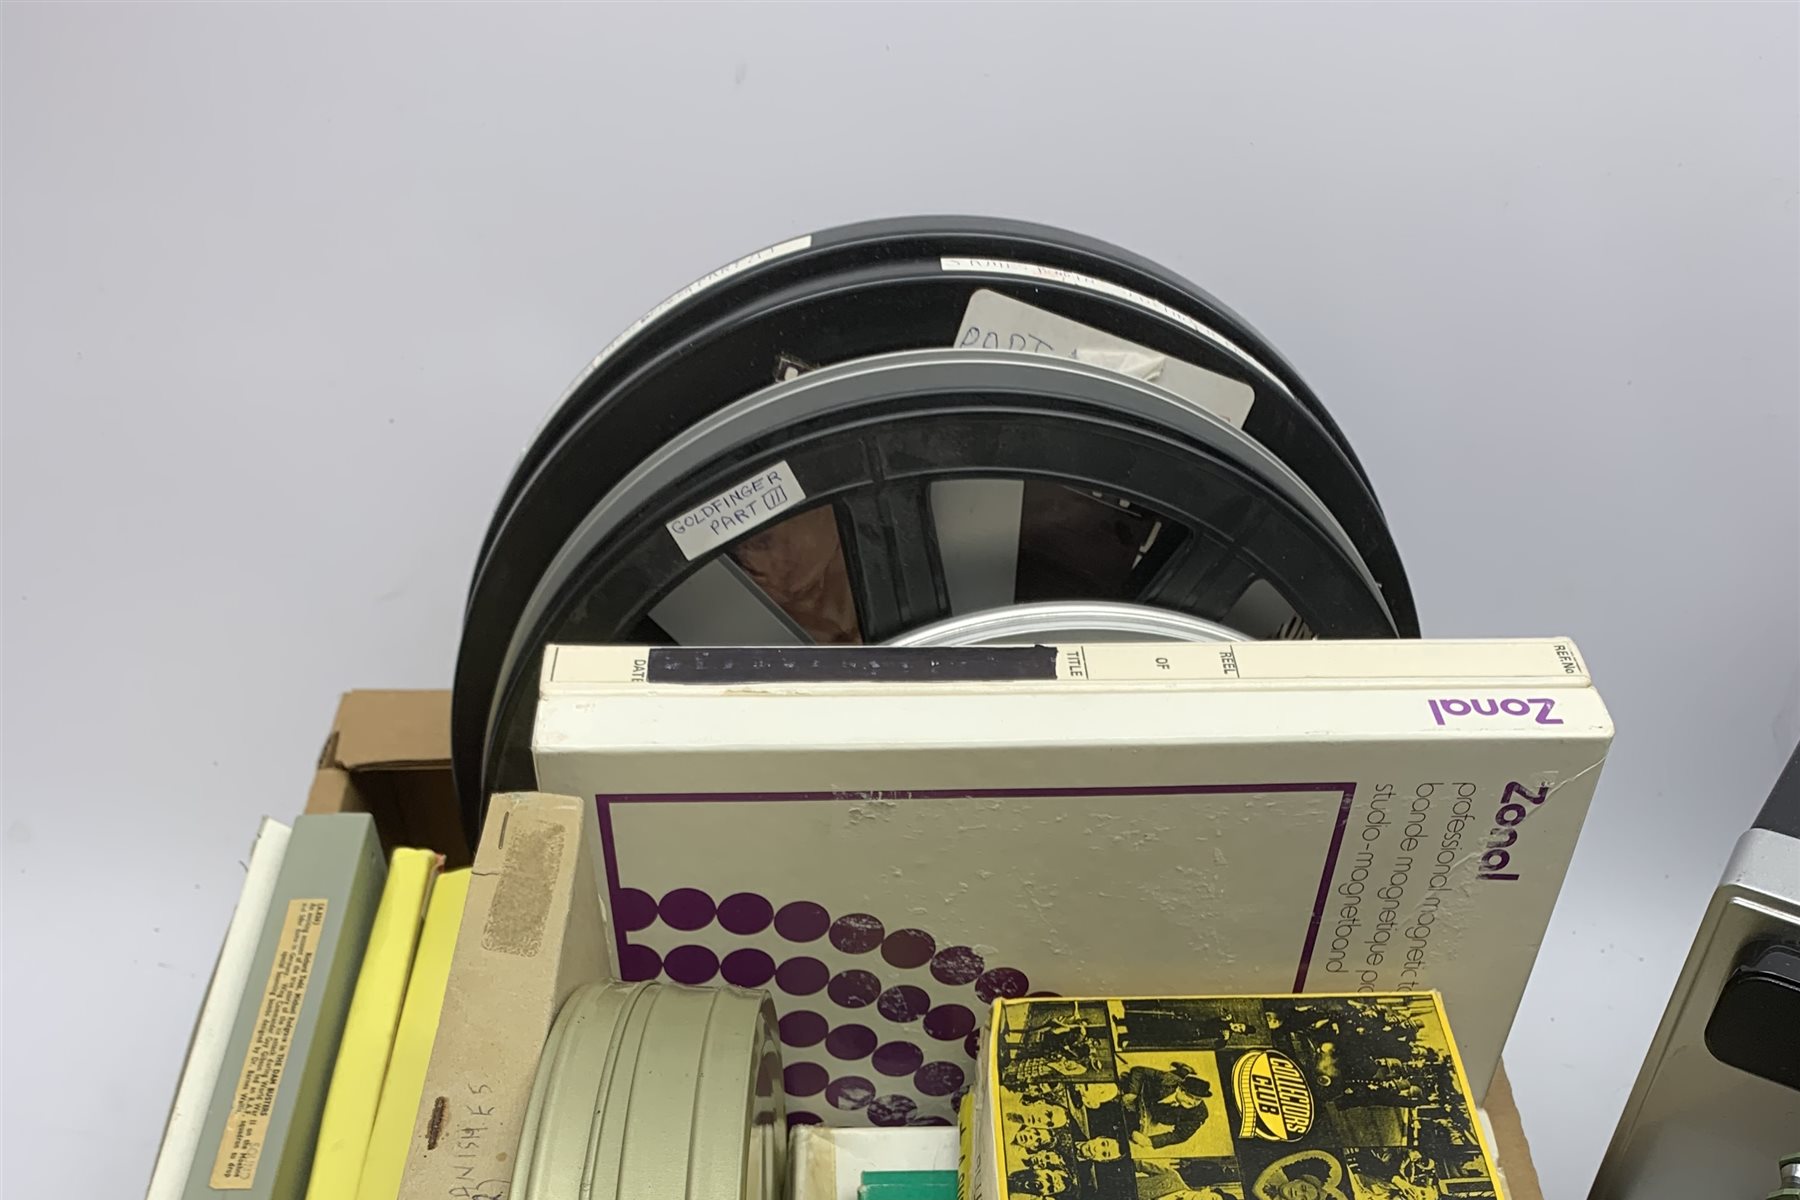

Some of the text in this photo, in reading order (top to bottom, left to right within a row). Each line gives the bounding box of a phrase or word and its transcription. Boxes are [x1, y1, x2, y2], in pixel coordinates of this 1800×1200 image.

[672, 471, 782, 534] GOLDFINGER
[710, 500, 757, 535] PART
[631, 659, 647, 682] DATE
[1066, 651, 1083, 677] TITLE
[1155, 657, 1170, 670] OF
[1219, 651, 1236, 675] REEL
[1428, 698, 1564, 725] Zonal
[1400, 782, 1445, 852] bande
[1476, 781, 1549, 881] Zonal
[1428, 782, 1477, 891] professional
[1326, 783, 1397, 973] studio-magnetband
[1364, 856, 1413, 966] magnetique
[1400, 897, 1441, 977] magnetic
[270, 1069, 280, 1084] DAM
[274, 1054, 284, 1066] THE
[260, 1088, 274, 1116] BUSTERS
[1252, 1074, 1280, 1116] CLUB
[1270, 1058, 1310, 1133] COLLECTORS
[224, 1162, 235, 1178] drop
